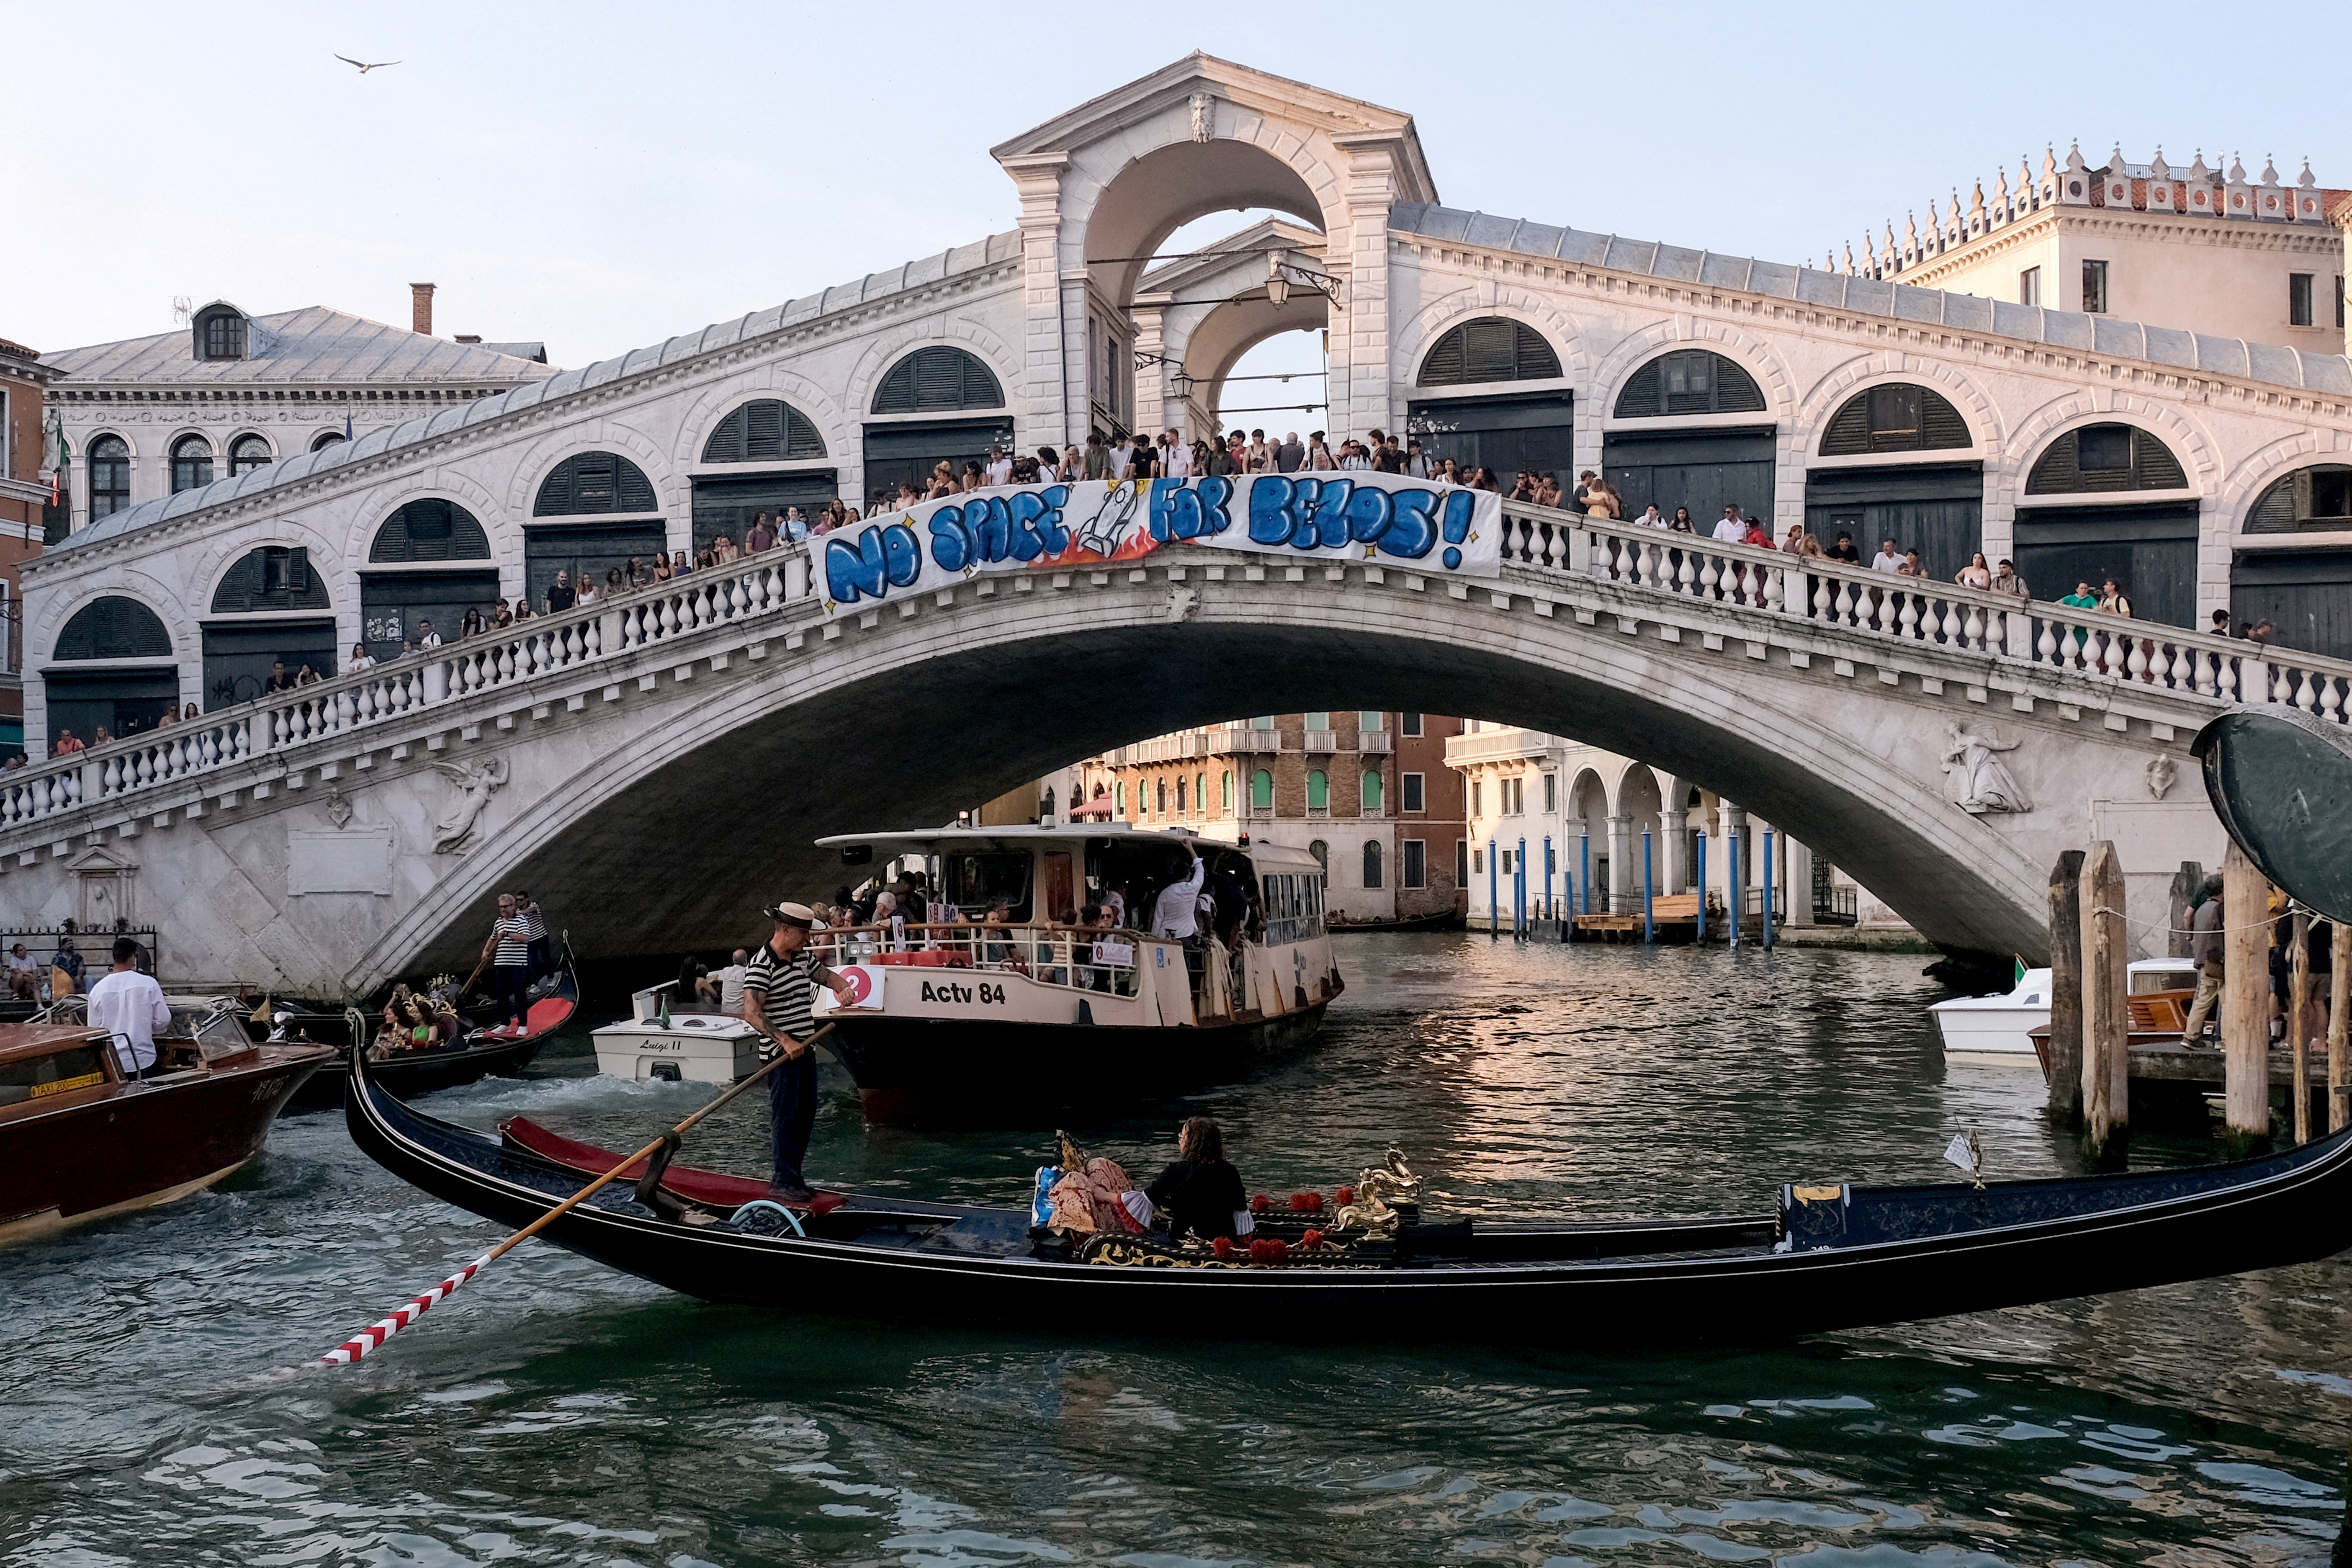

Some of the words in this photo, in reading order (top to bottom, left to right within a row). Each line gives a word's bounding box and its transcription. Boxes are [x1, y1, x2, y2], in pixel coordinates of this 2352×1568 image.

[826, 524, 922, 603] NO
[929, 485, 1071, 572] SPACE
[1150, 476, 1234, 542] FOR
[1248, 476, 1475, 569] BEZOS!
[921, 981, 972, 1003] Actv
[979, 983, 1006, 1004] 84
[640, 1039, 669, 1052] Luigi
[672, 1041, 681, 1050] II
